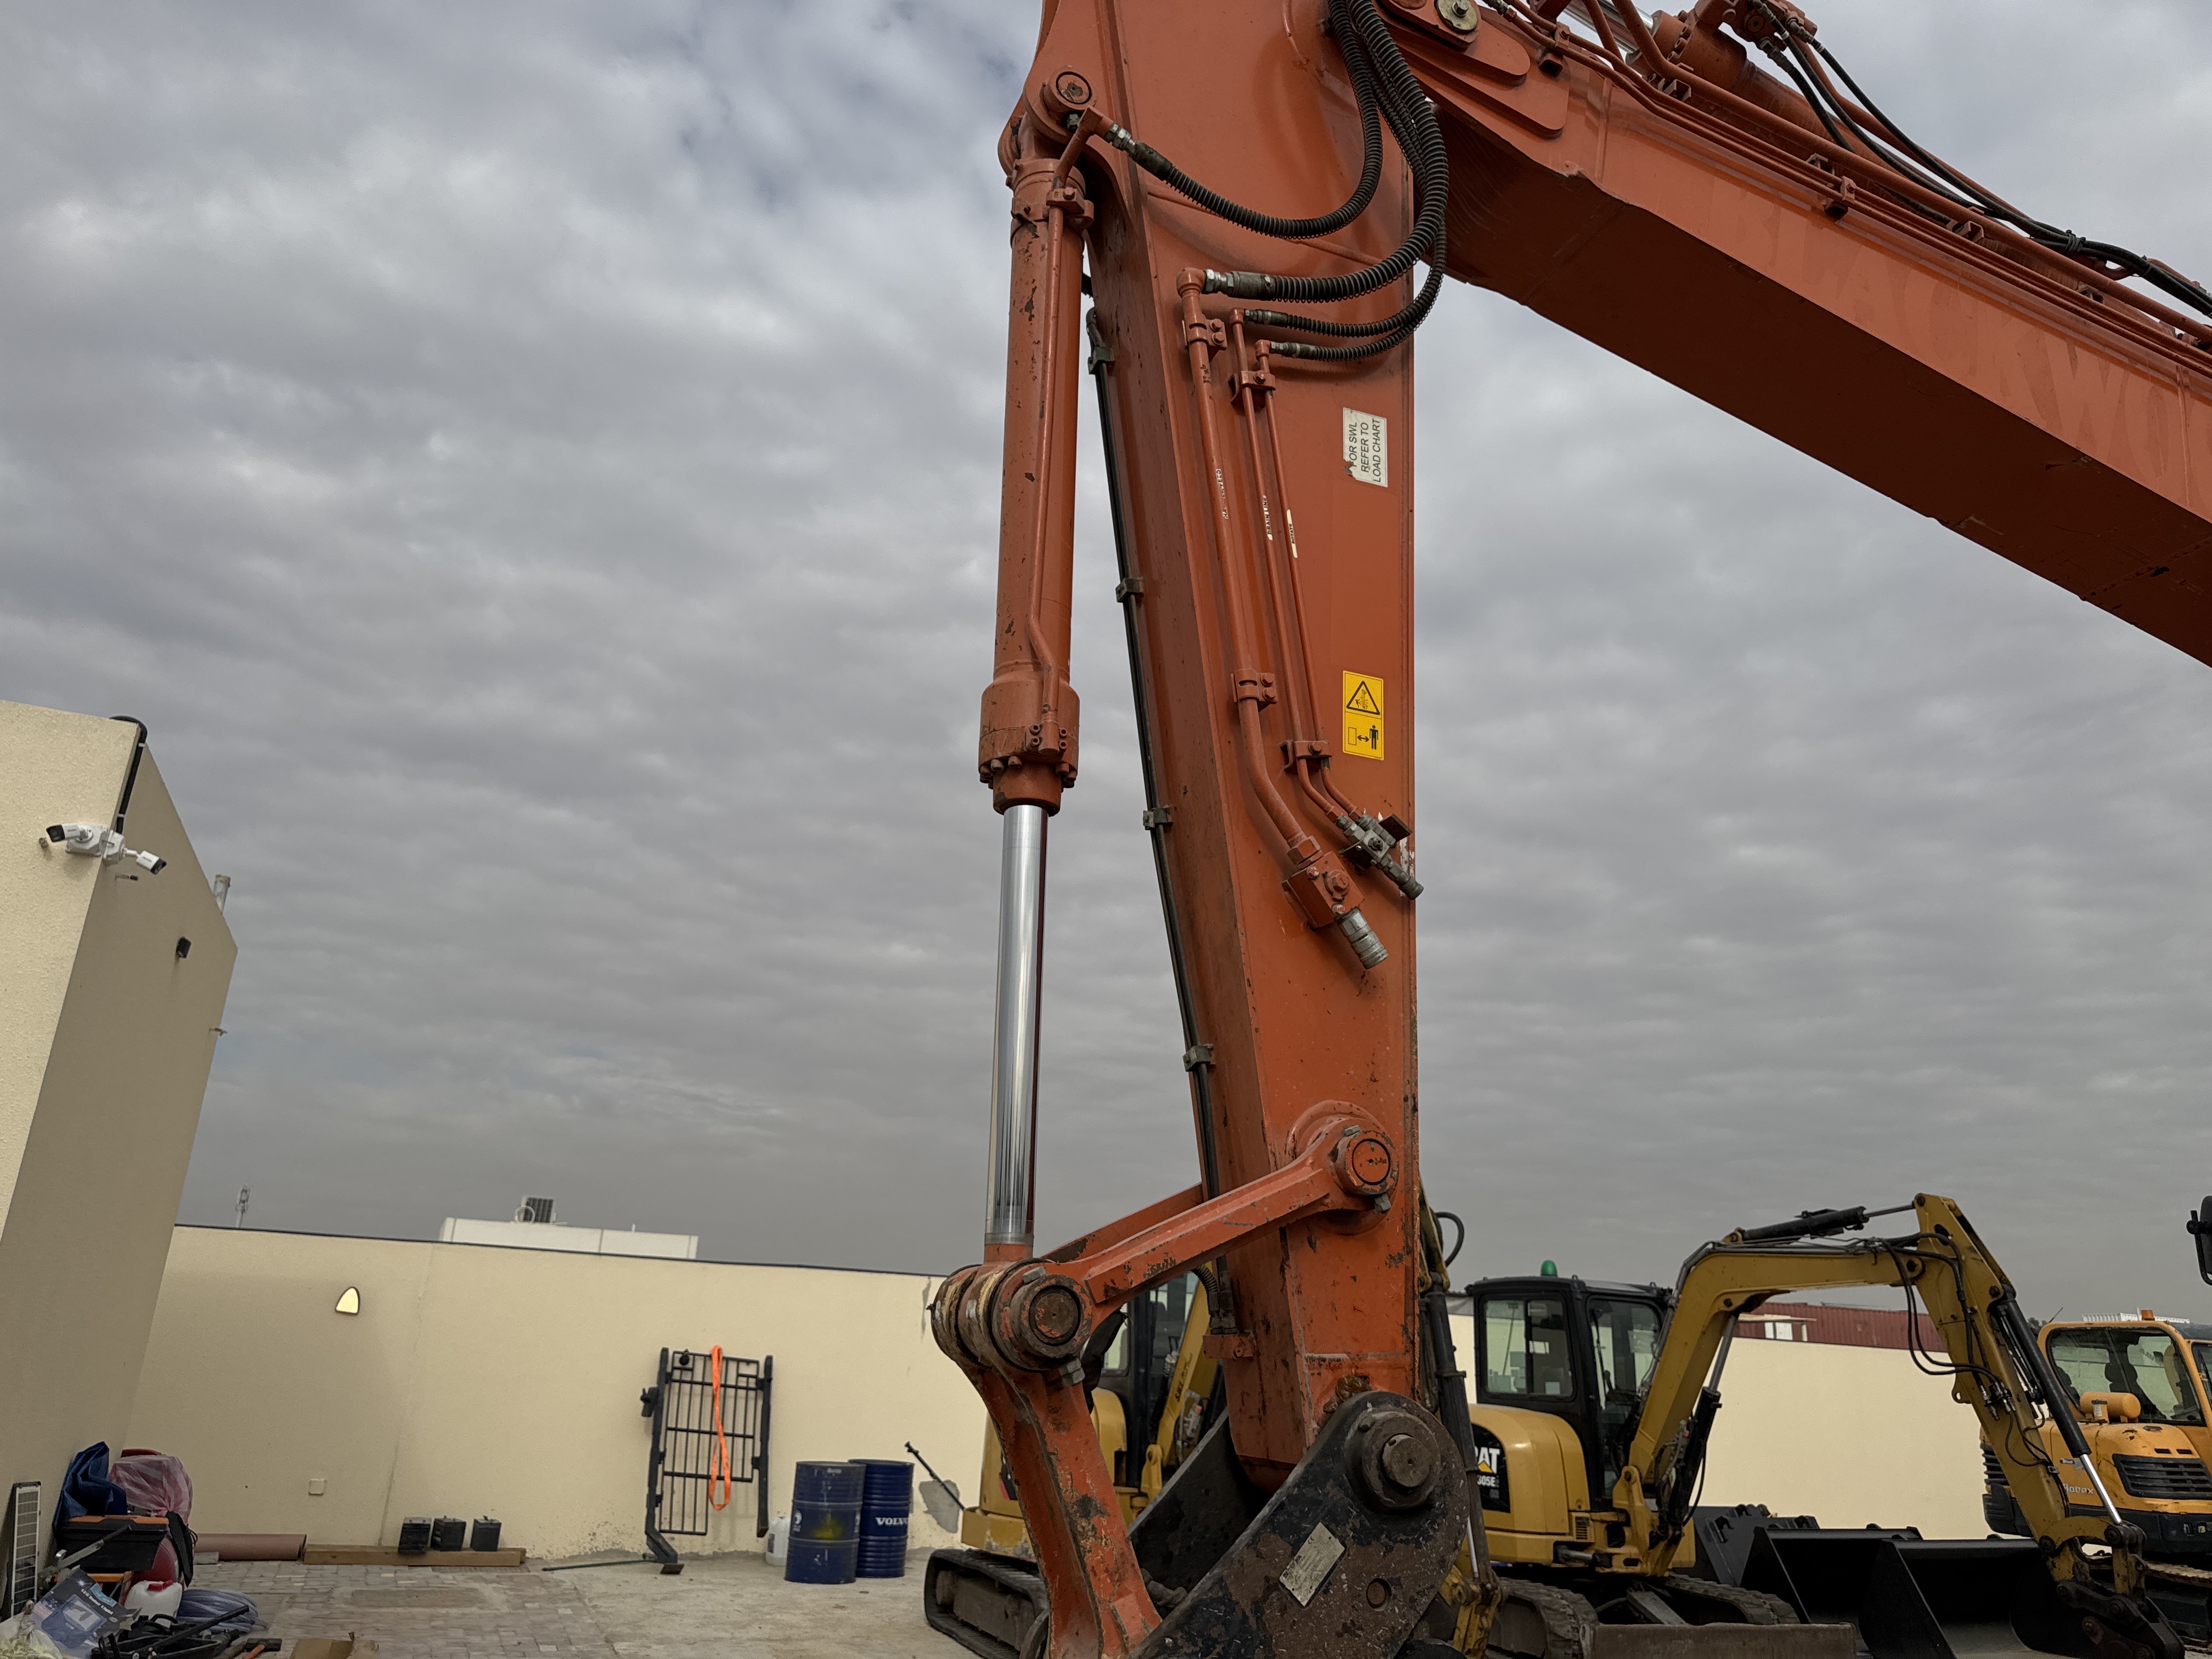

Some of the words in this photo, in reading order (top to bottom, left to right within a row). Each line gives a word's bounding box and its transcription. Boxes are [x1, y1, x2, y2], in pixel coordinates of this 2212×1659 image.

[1349, 422, 1357, 443] SWL
[1361, 422, 1369, 436] TO
[1372, 418, 1381, 453] CHART
[1361, 439, 1369, 473] REFER
[1373, 455, 1381, 483] LOAD
